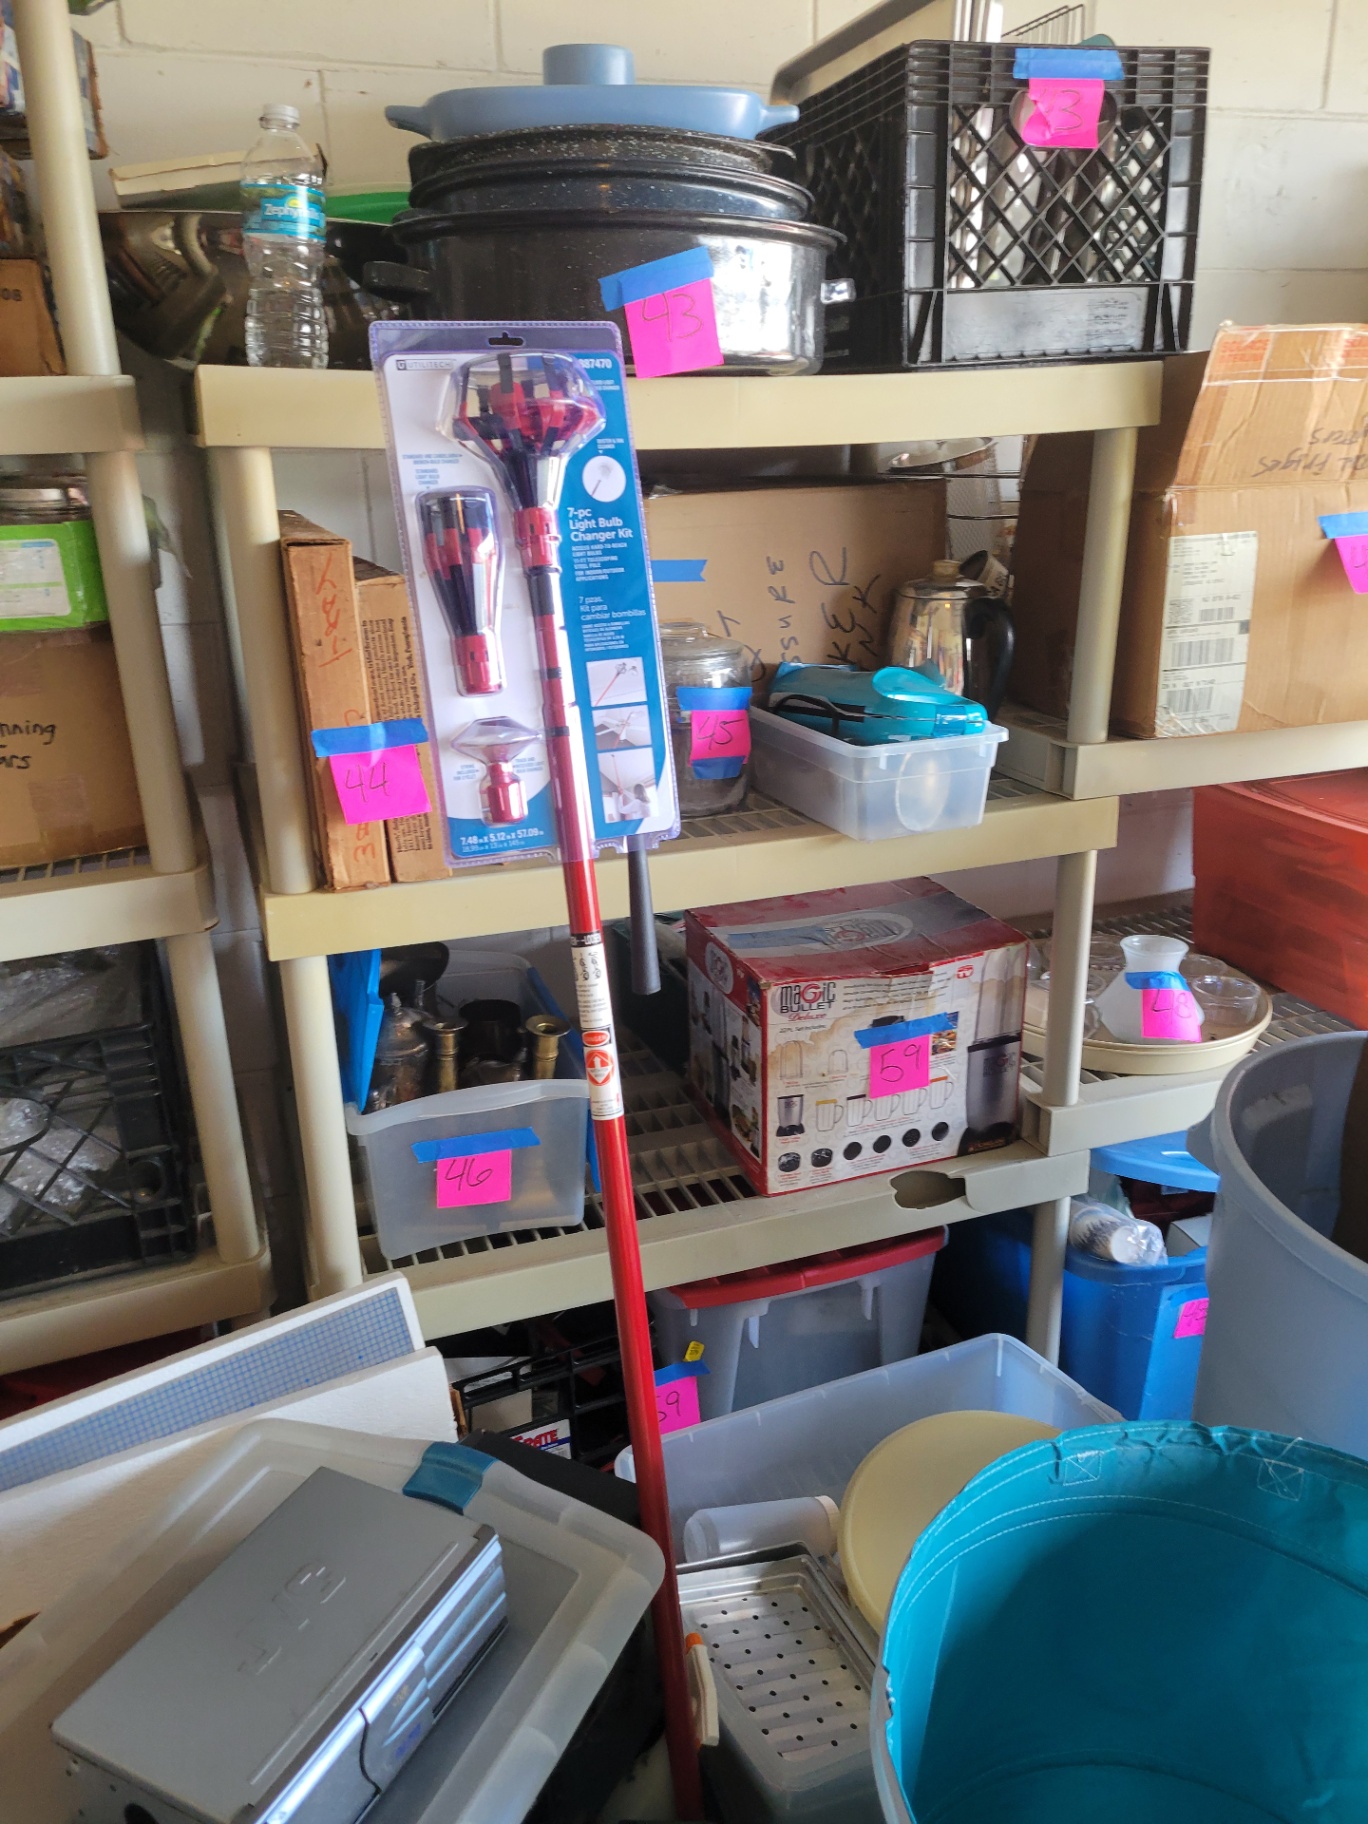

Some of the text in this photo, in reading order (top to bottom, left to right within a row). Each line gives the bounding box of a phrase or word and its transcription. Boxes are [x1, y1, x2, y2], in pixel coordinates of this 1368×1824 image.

[642, 292, 702, 342] 43
[408, 360, 451, 369] UTILITECH
[567, 507, 592, 519] 7-pc
[569, 516, 623, 531] Light Bulb
[570, 528, 633, 542] Changer Kit
[579, 596, 584, 604] 7
[591, 605, 608, 613] para
[611, 609, 647, 618] bombillas
[696, 715, 744, 751] 45
[345, 762, 390, 802] 44
[780, 1000, 835, 1013] BULLET
[1152, 989, 1192, 1025] 48
[880, 1044, 921, 1082] 59
[445, 1158, 493, 1191] 46
